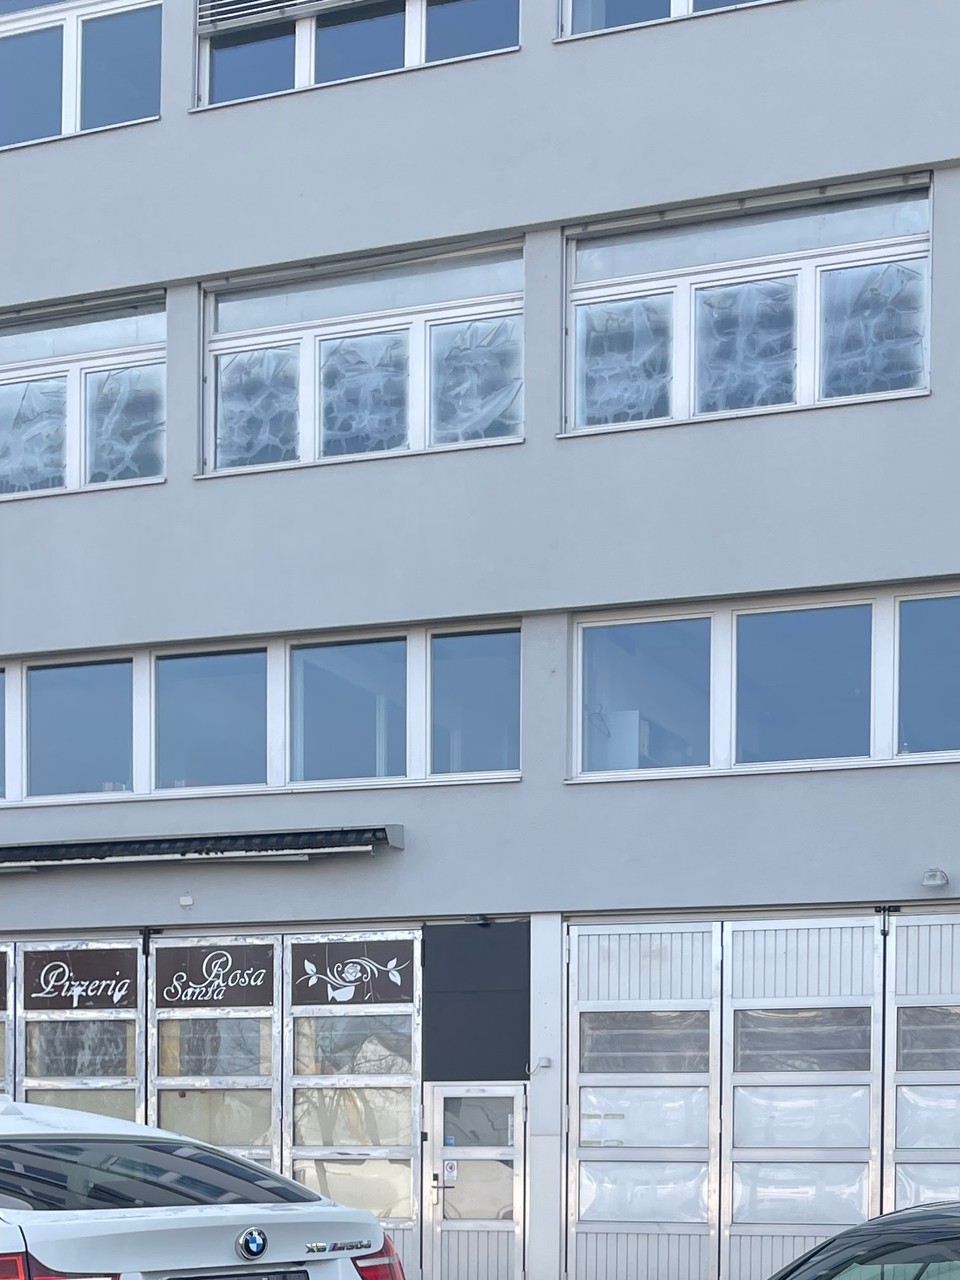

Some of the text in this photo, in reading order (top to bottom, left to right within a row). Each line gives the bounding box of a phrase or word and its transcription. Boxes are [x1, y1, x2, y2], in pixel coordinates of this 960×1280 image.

[31, 961, 131, 1004] Pizzeria
[163, 950, 267, 1002] Santa Rosa
